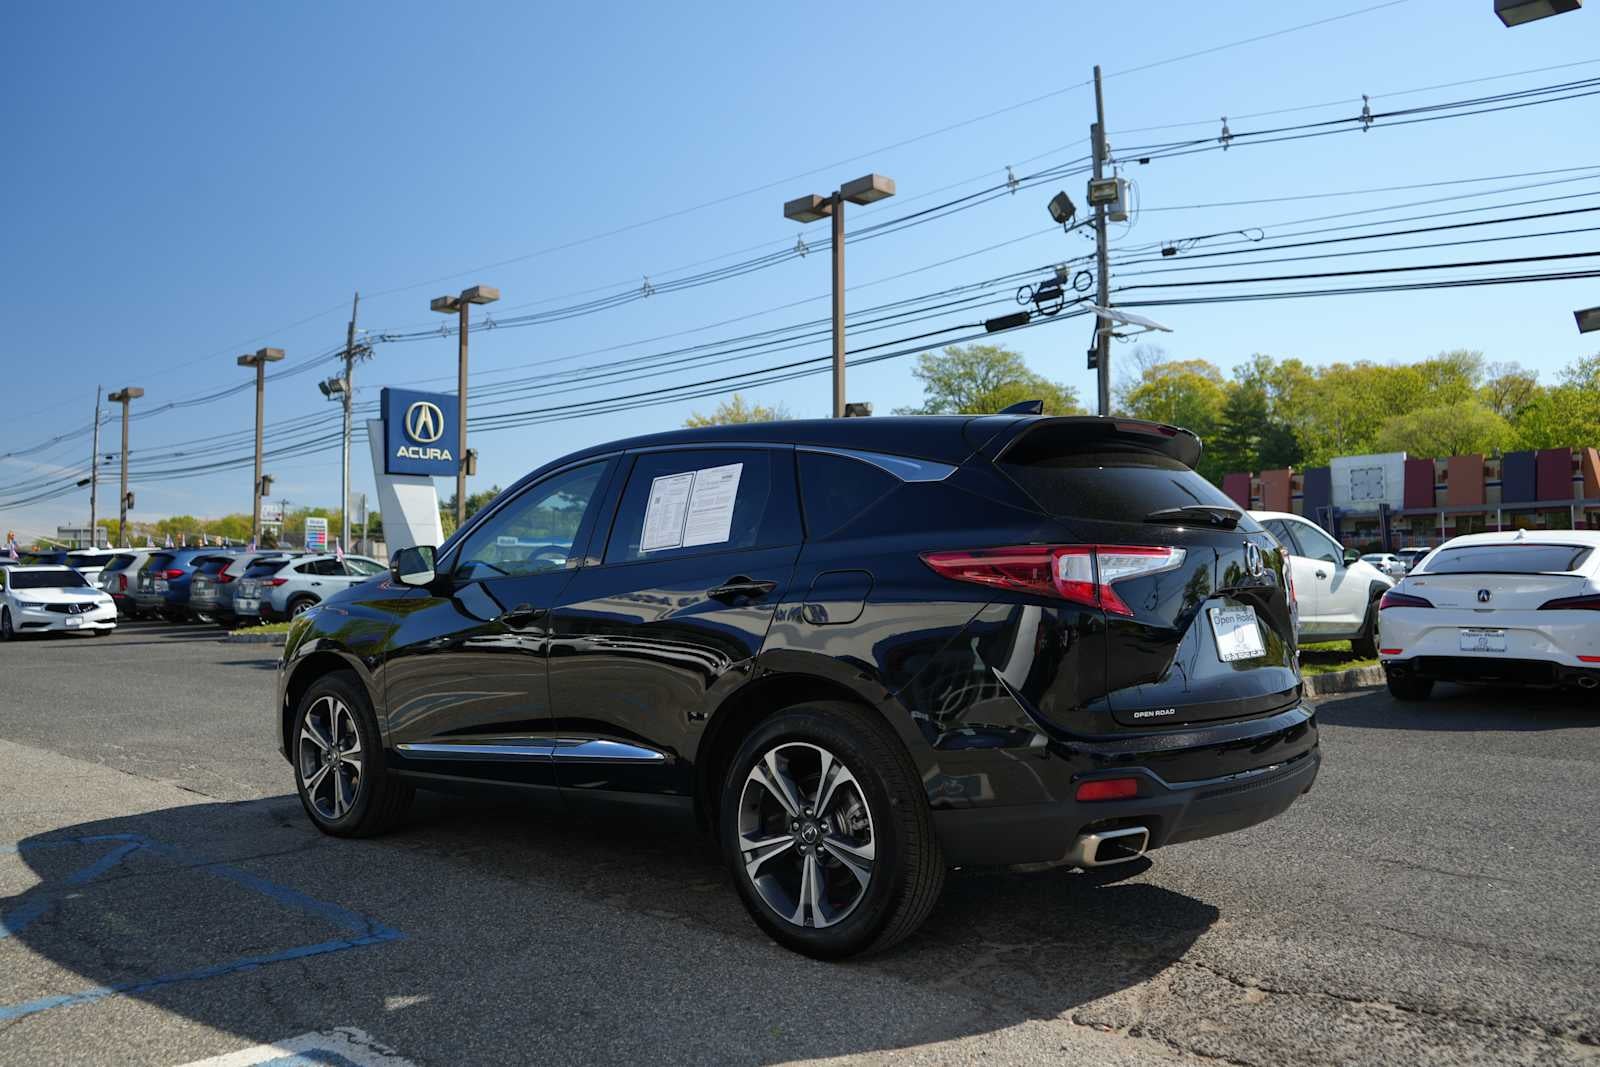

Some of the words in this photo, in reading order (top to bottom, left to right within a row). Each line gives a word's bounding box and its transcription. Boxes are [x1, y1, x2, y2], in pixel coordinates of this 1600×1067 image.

[397, 446, 452, 461] ACURA
[1214, 616, 1235, 626] Open
[1155, 708, 1175, 716] ROAD
